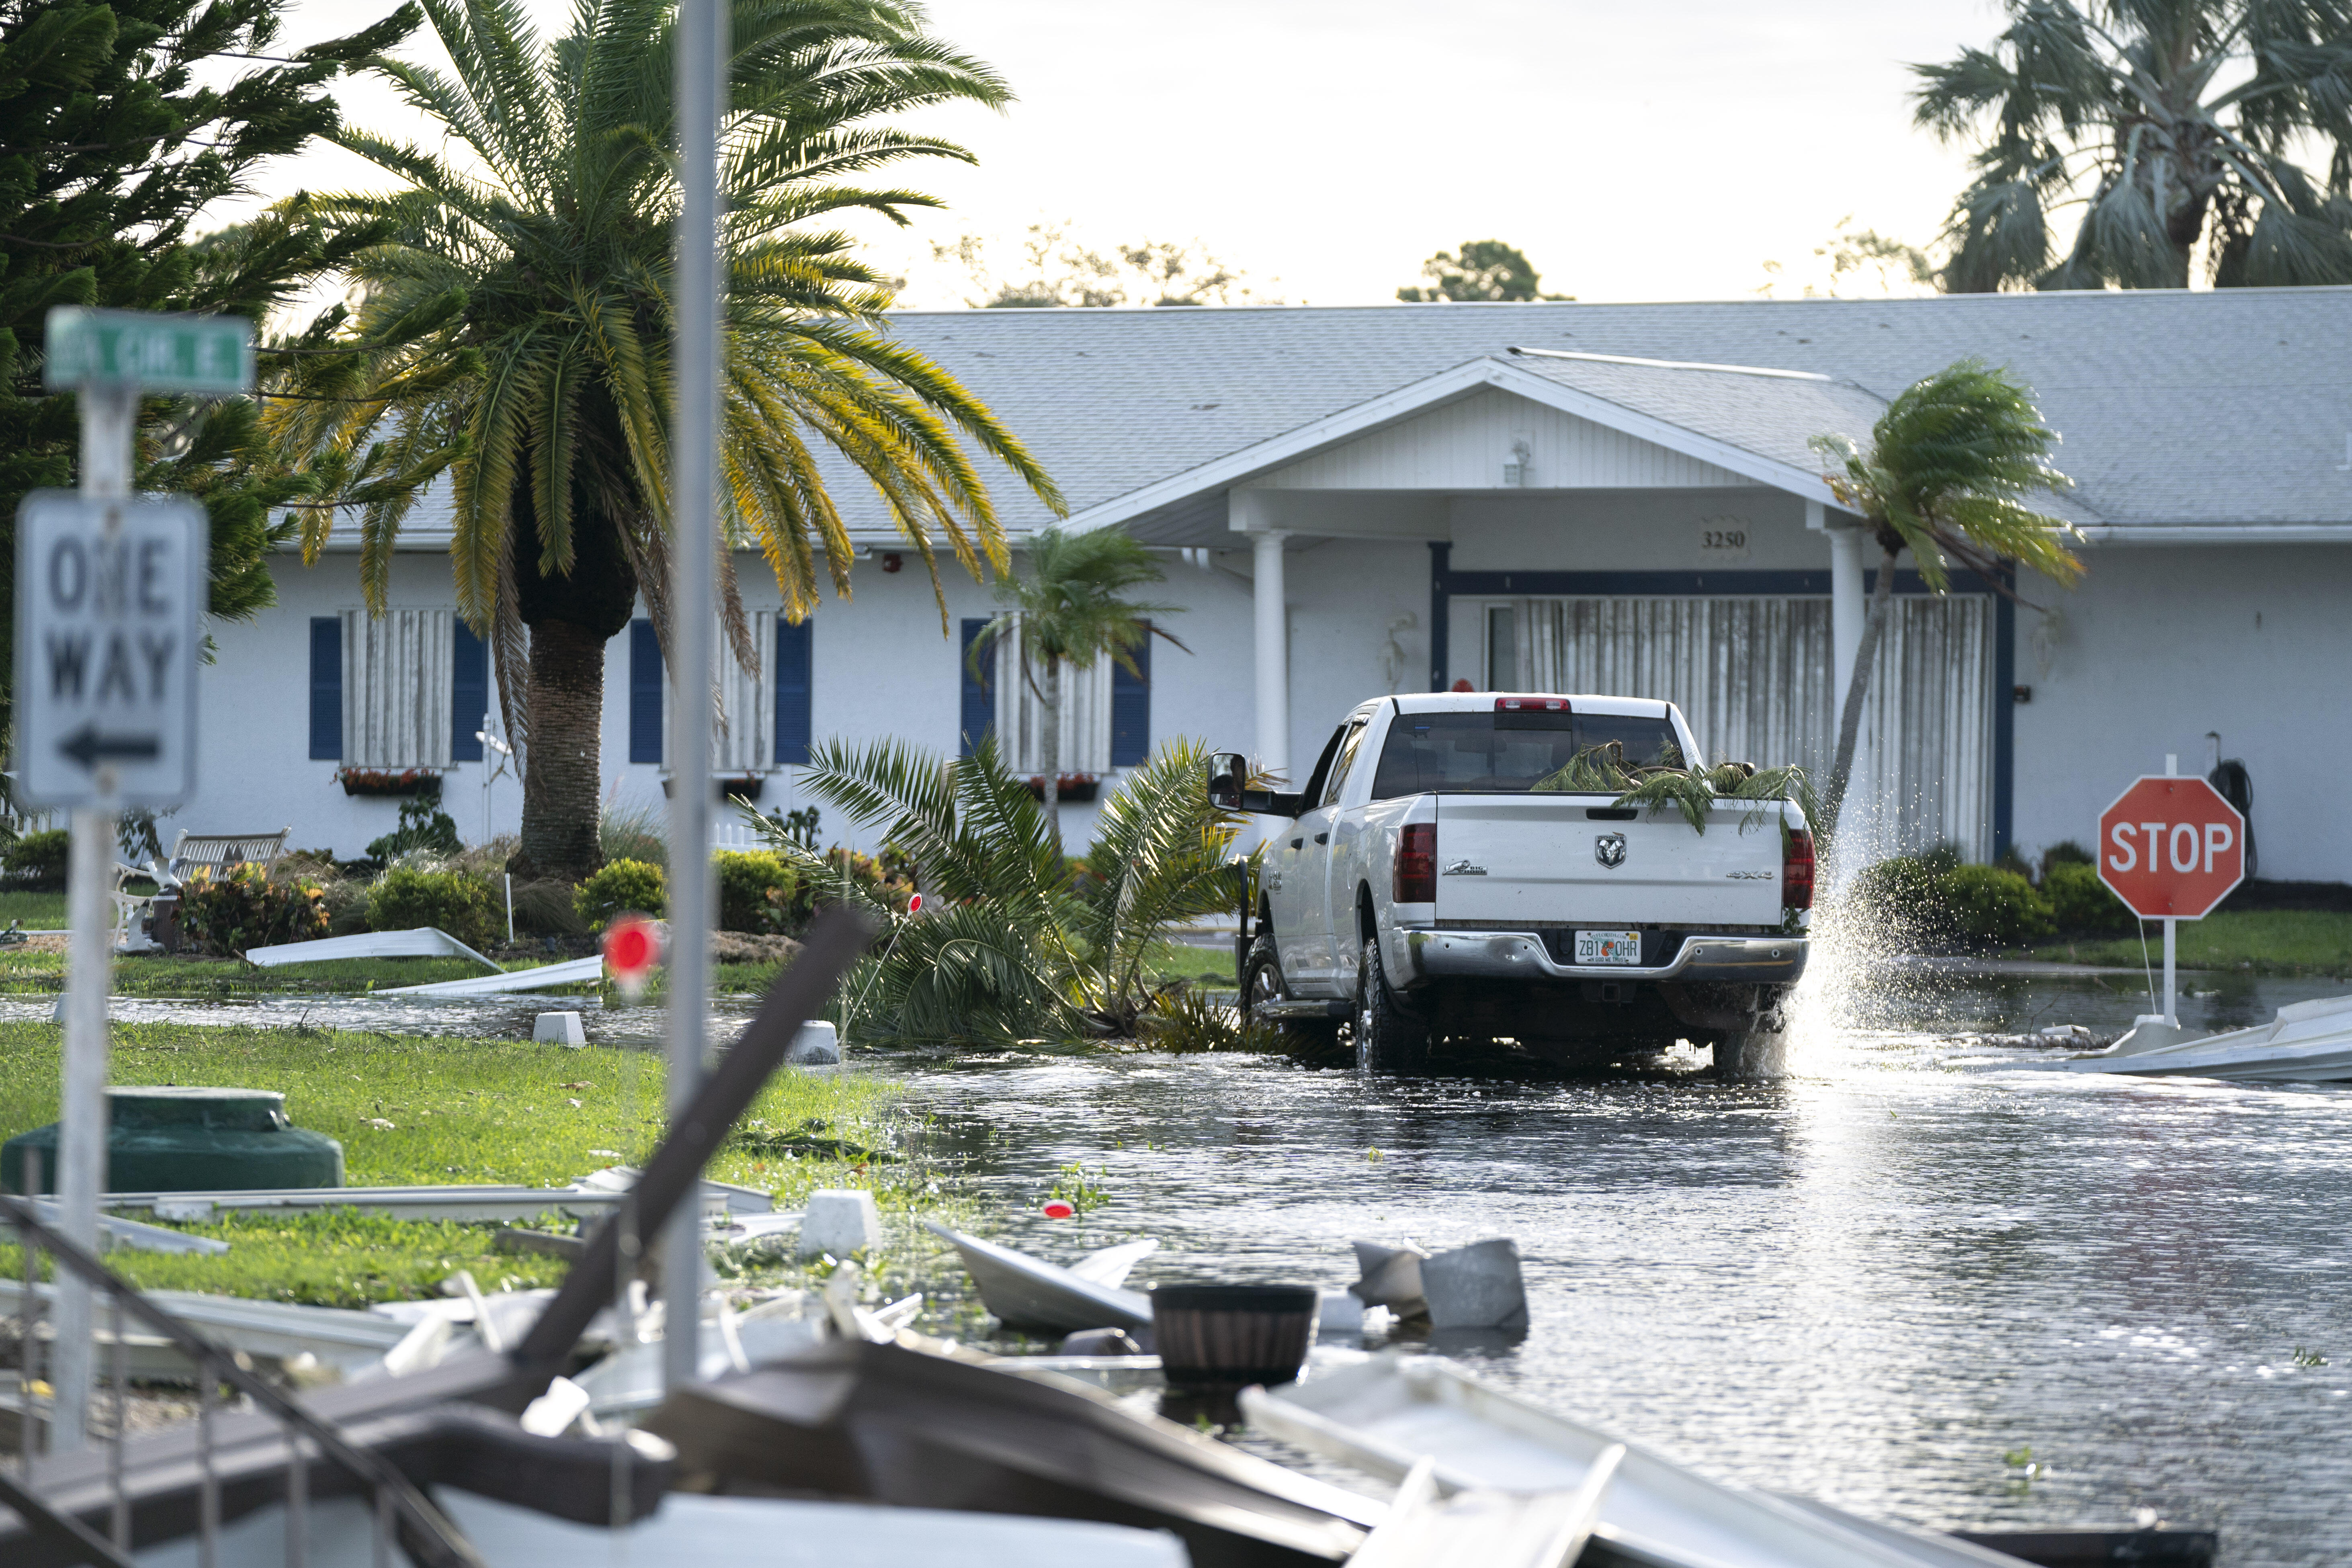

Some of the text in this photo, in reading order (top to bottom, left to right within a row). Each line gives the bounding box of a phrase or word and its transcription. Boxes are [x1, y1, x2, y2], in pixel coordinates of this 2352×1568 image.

[1702, 530, 1746, 549] 3250
[46, 535, 171, 616] ONE
[43, 629, 175, 702] WAY
[2109, 822, 2233, 873] STOP
[1580, 940, 1598, 956] Z81
